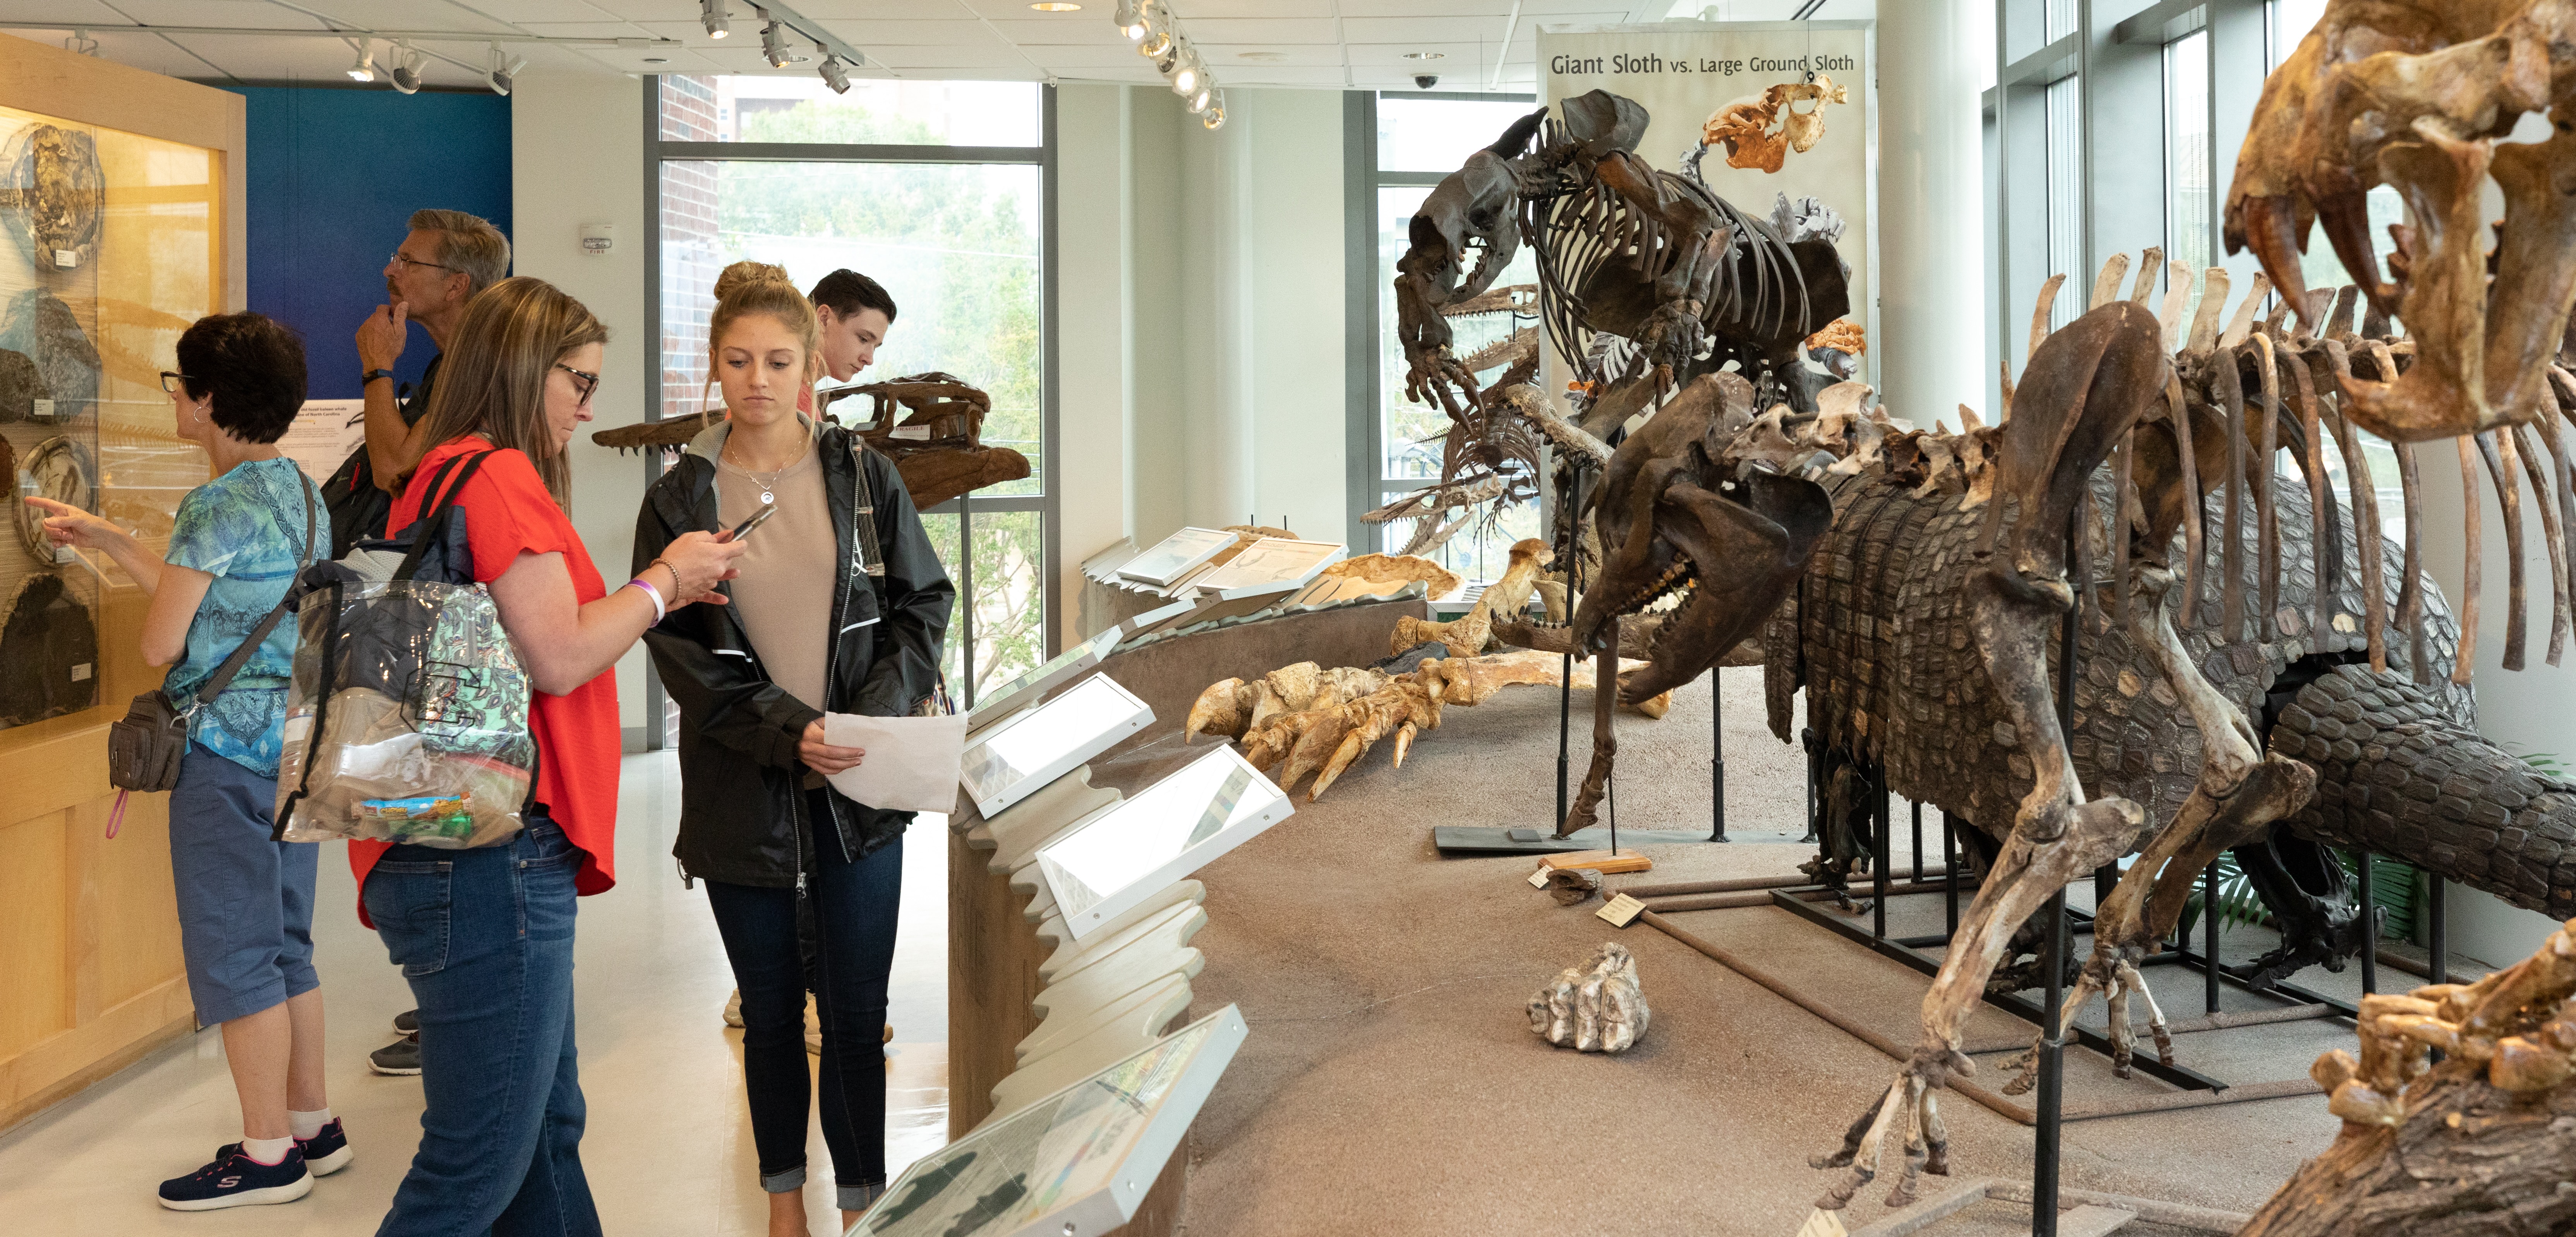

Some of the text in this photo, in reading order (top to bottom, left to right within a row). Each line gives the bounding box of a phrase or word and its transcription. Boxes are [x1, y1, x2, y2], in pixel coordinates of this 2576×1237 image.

[1551, 53, 1854, 76] Giant Sloth vs. Large Ground Sloth
[216, 1175, 242, 1188] S
